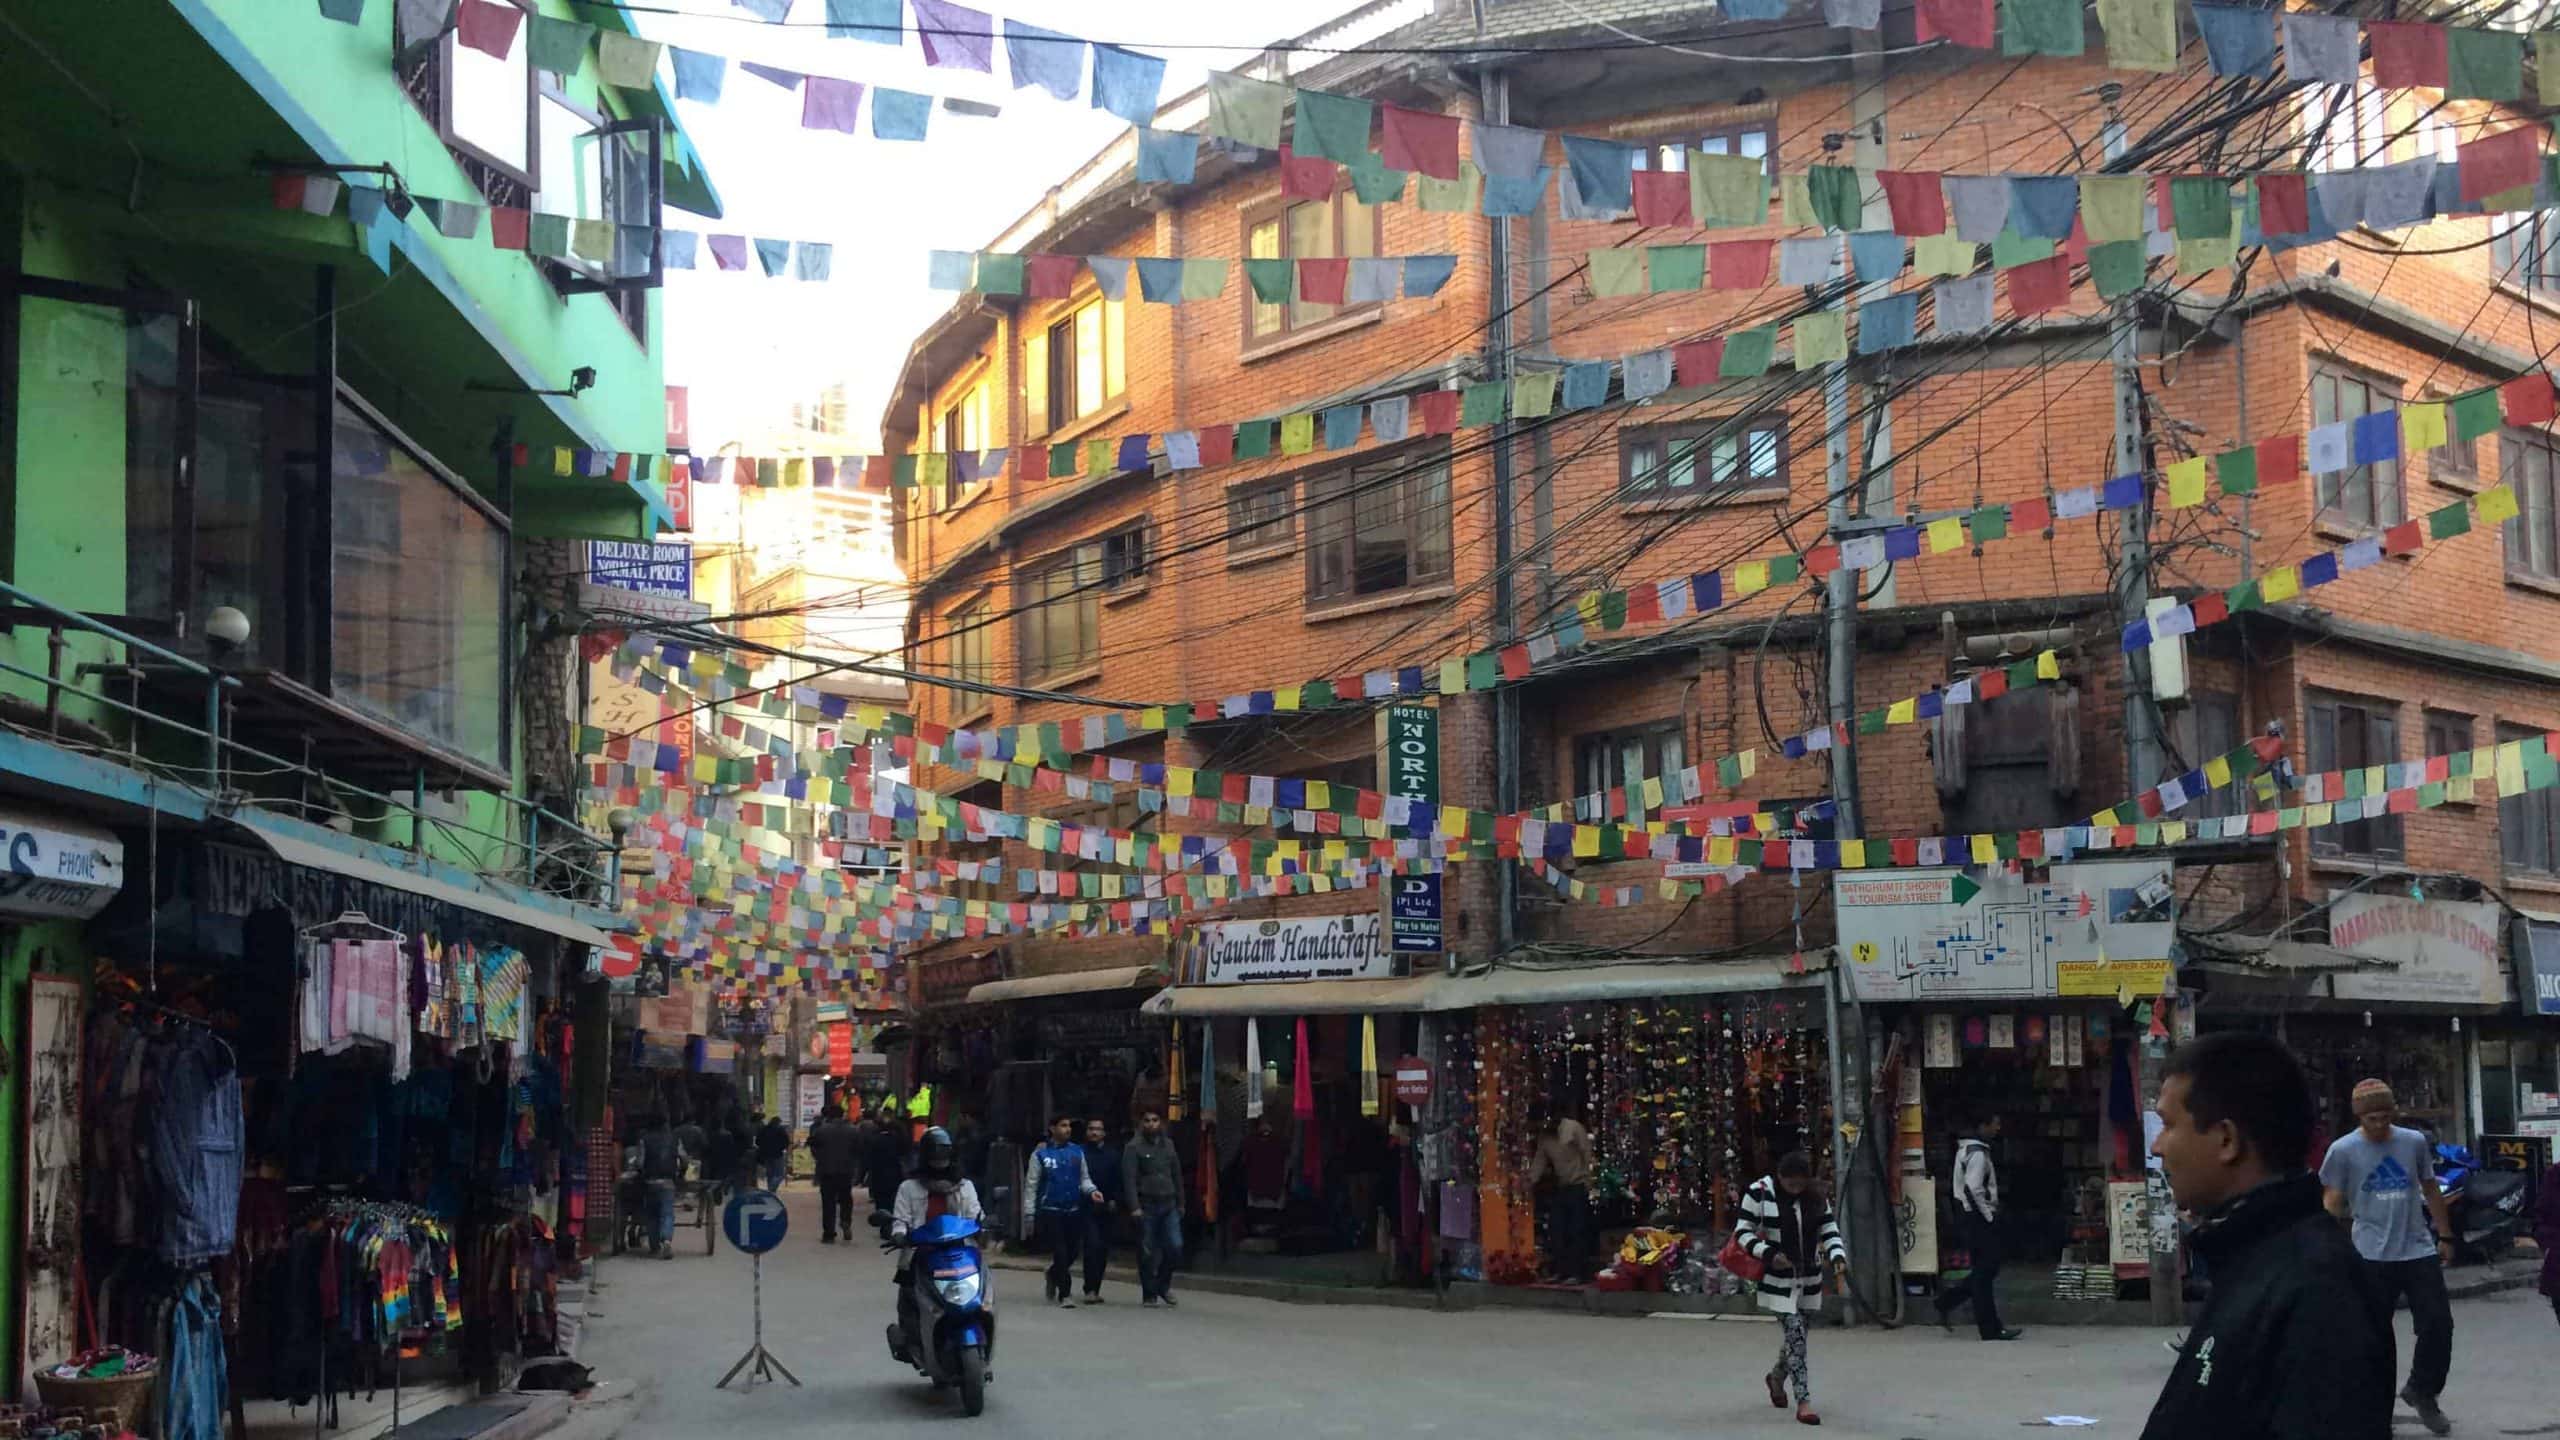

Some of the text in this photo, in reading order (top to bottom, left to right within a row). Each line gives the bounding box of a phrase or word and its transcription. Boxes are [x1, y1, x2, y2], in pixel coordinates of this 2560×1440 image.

[596, 540, 685, 562] DELUXE ROOM
[596, 560, 685, 582] NORMAL PRICE
[1393, 707, 1431, 720] HOTEL
[58, 850, 96, 880] PHONE
[1904, 879, 1950, 893] SHOPING
[1903, 891, 1942, 903] STREET
[2333, 904, 2404, 949] NAMASTE
[2407, 902, 2446, 932] GOLD
[1210, 918, 1391, 978] Gautam Handicraft
[1859, 943, 1870, 955] N
[1043, 1156, 1058, 1169] 21
